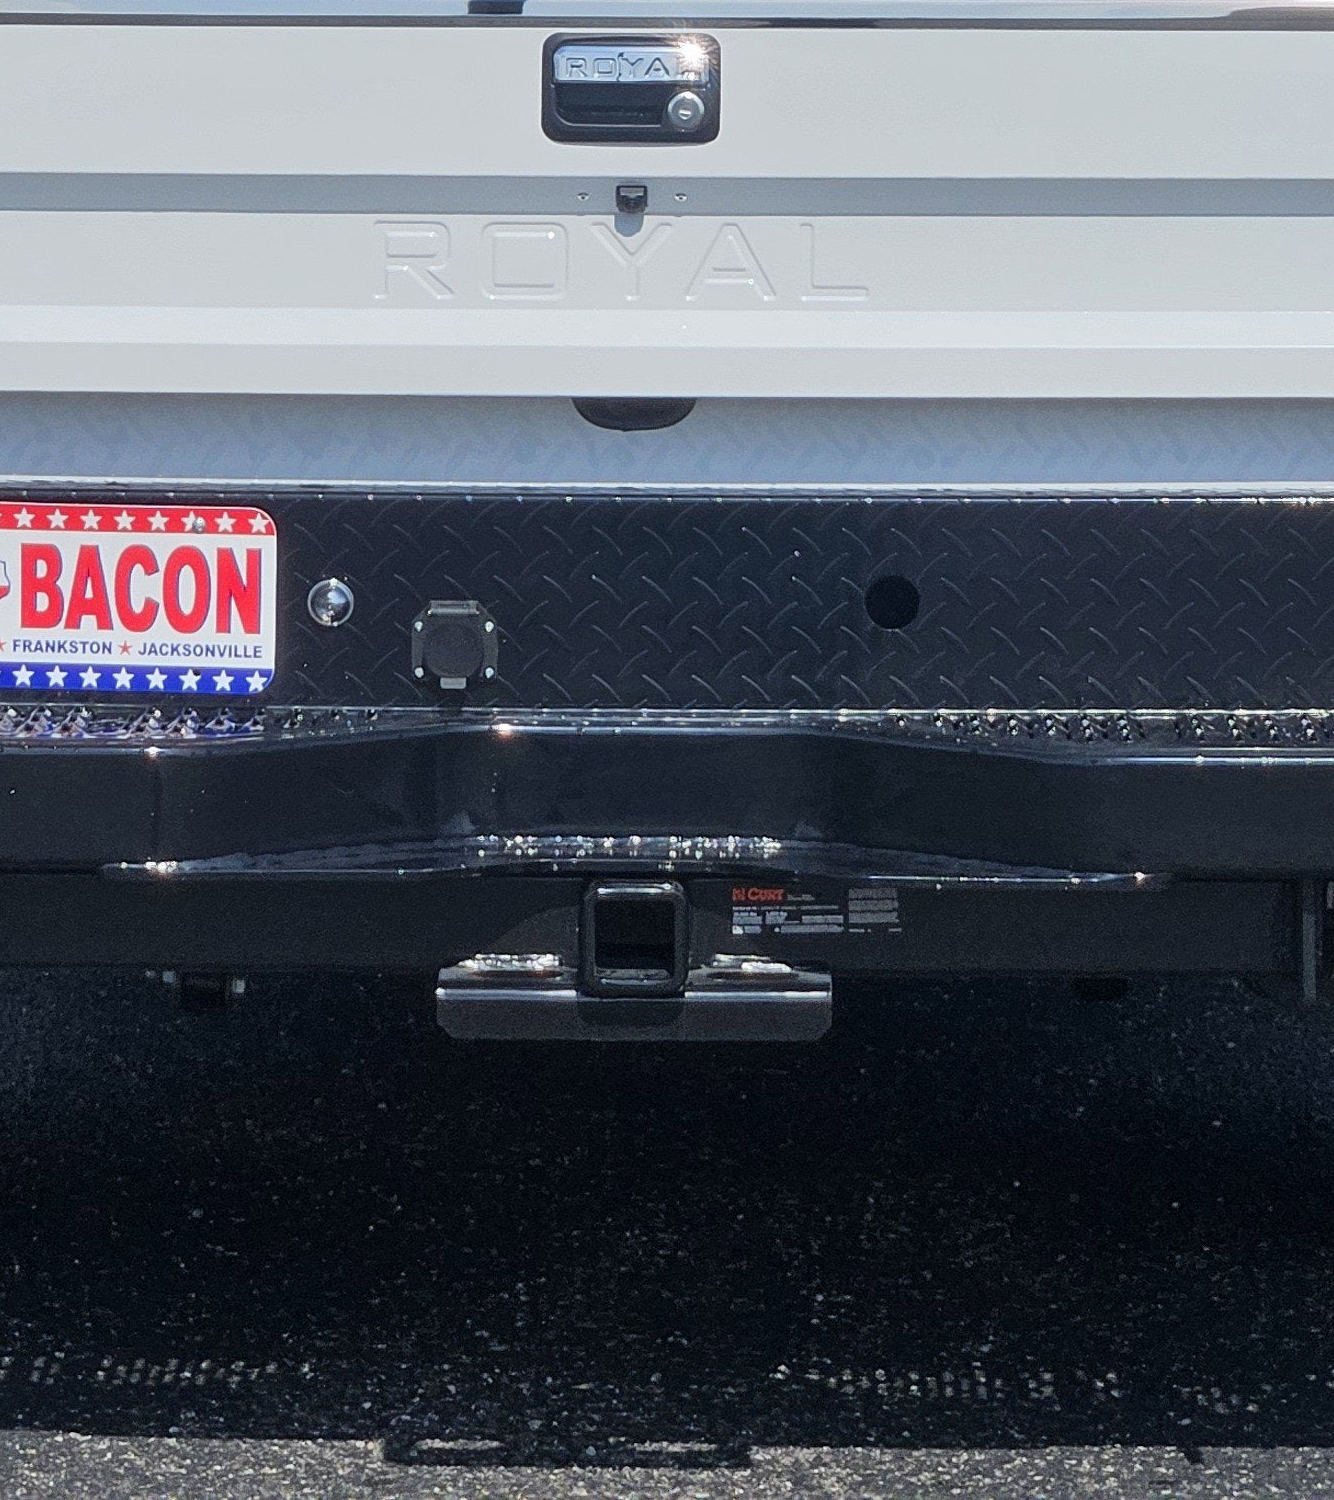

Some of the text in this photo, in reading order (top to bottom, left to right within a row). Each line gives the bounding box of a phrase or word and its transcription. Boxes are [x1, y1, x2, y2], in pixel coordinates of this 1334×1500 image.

[373, 220, 870, 301] ROYAL
[20, 542, 263, 635] BACON
[12, 639, 113, 655] FRANKSTON
[138, 641, 263, 659] JACKSONVILLE
